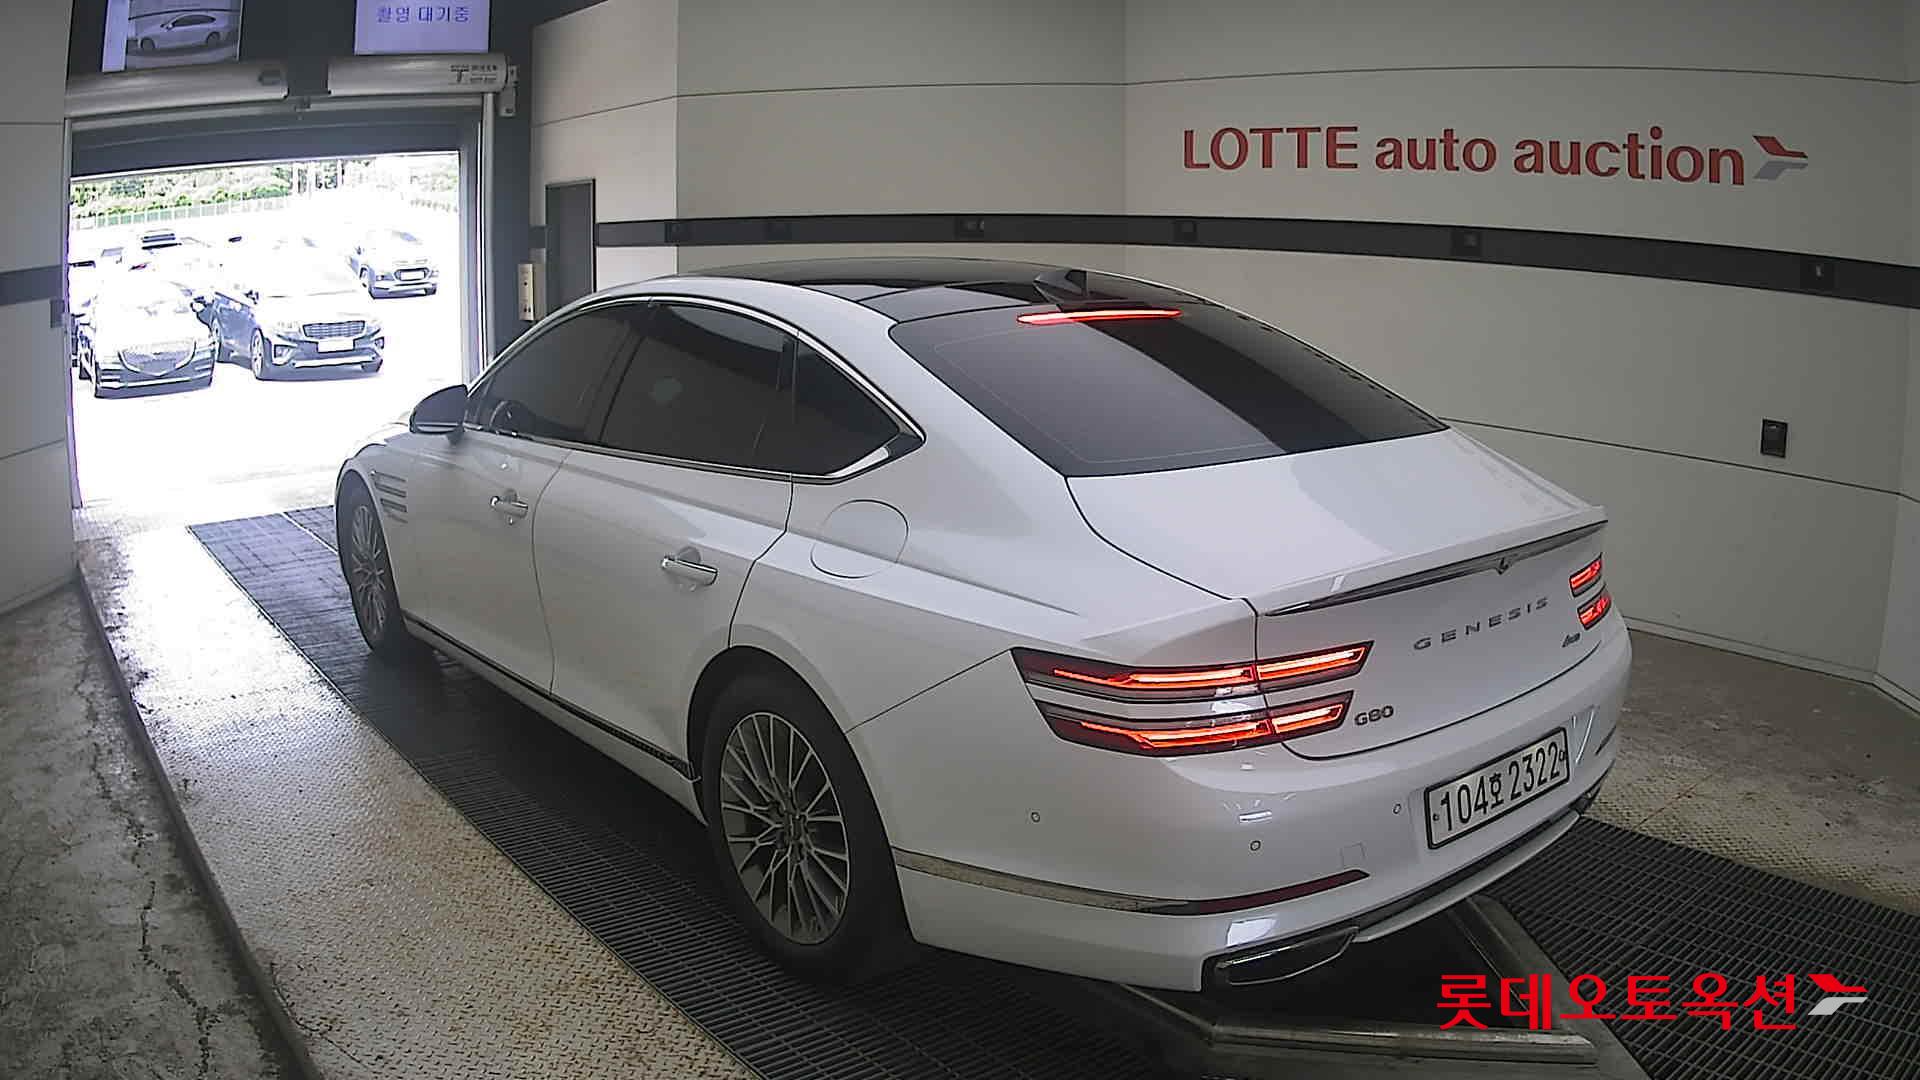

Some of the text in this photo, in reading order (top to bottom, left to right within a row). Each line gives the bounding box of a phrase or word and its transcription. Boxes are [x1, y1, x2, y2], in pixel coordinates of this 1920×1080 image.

[418, 5, 471, 23] 대기중
[1183, 126, 1746, 186] LOTTE auto auction
[1413, 596, 1550, 651] GENESIS
[1354, 705, 1395, 727] G80
[1440, 741, 1560, 831] 104호 2322
